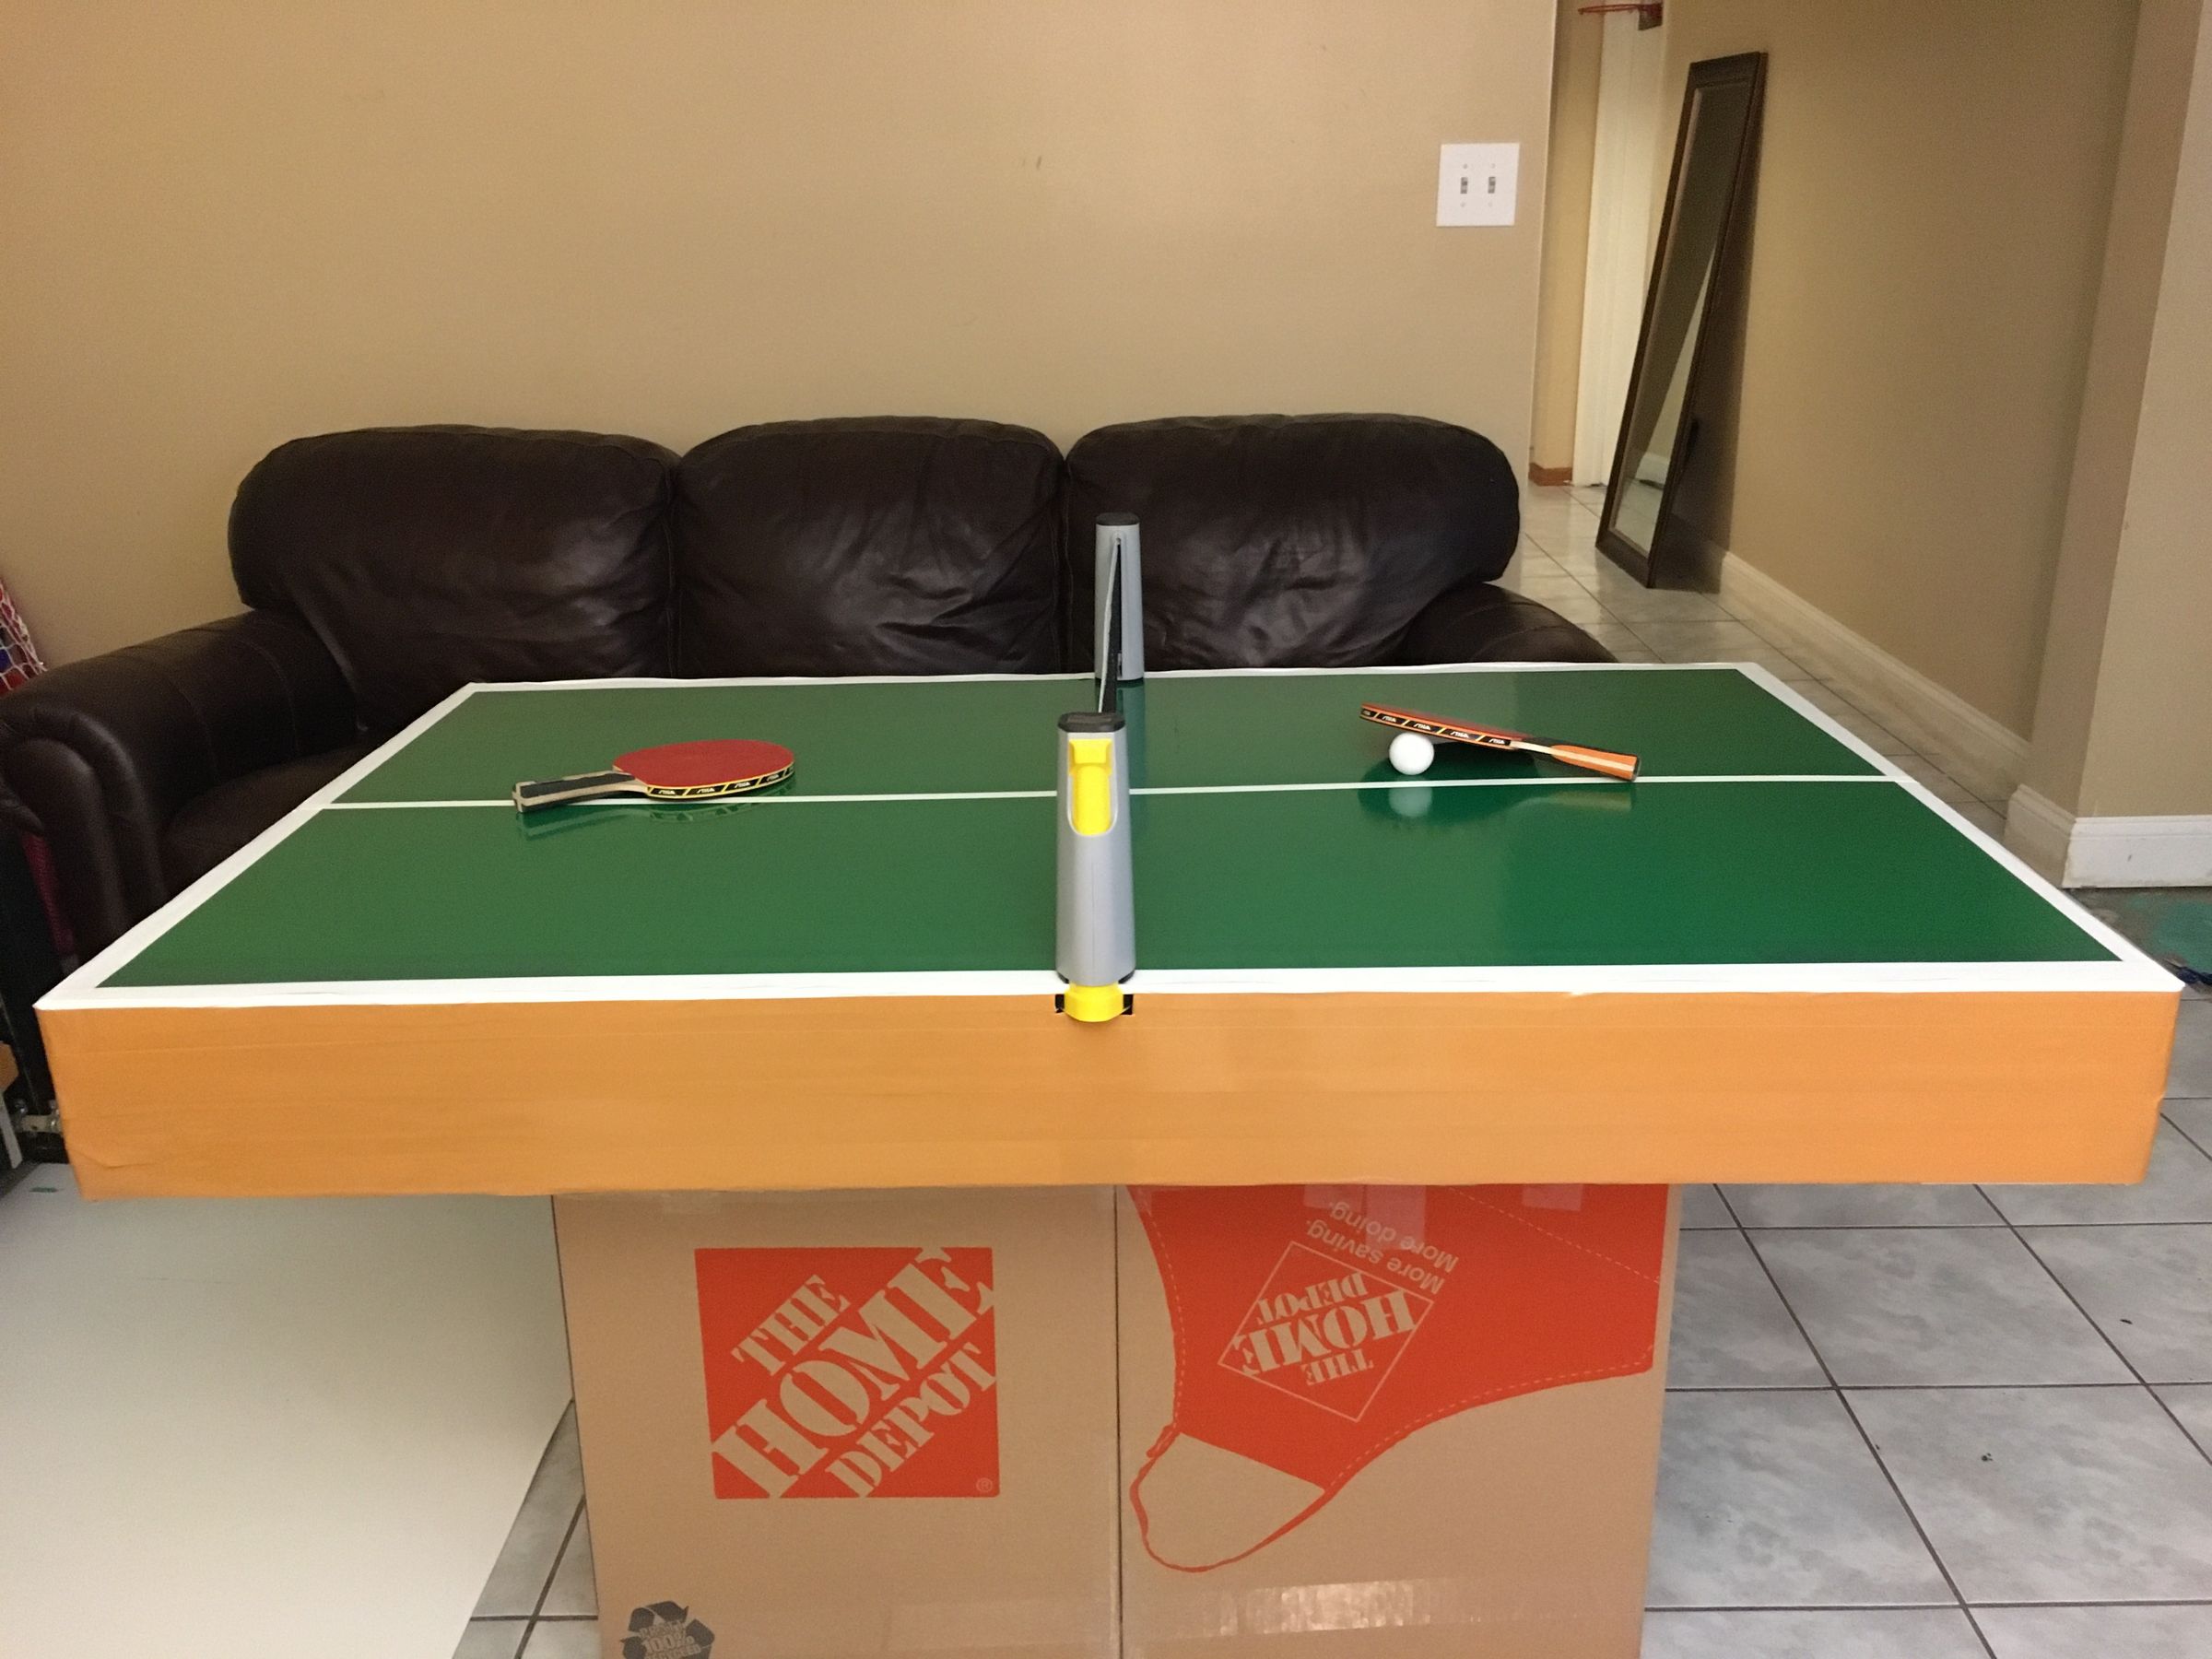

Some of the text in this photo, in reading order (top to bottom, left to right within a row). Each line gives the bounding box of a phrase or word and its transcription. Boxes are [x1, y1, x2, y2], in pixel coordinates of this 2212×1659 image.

[1306, 1218, 1445, 1295] More saving.
[1328, 1201, 1459, 1273] More doing.
[731, 1274, 852, 1377] THE
[1230, 1289, 1417, 1377] HOME
[1257, 1272, 1369, 1325] DEPOT
[712, 1247, 995, 1499] HOME
[1300, 1348, 1374, 1386] THE
[825, 1342, 997, 1499] DEPOT
[641, 1630, 695, 1654] 100%
